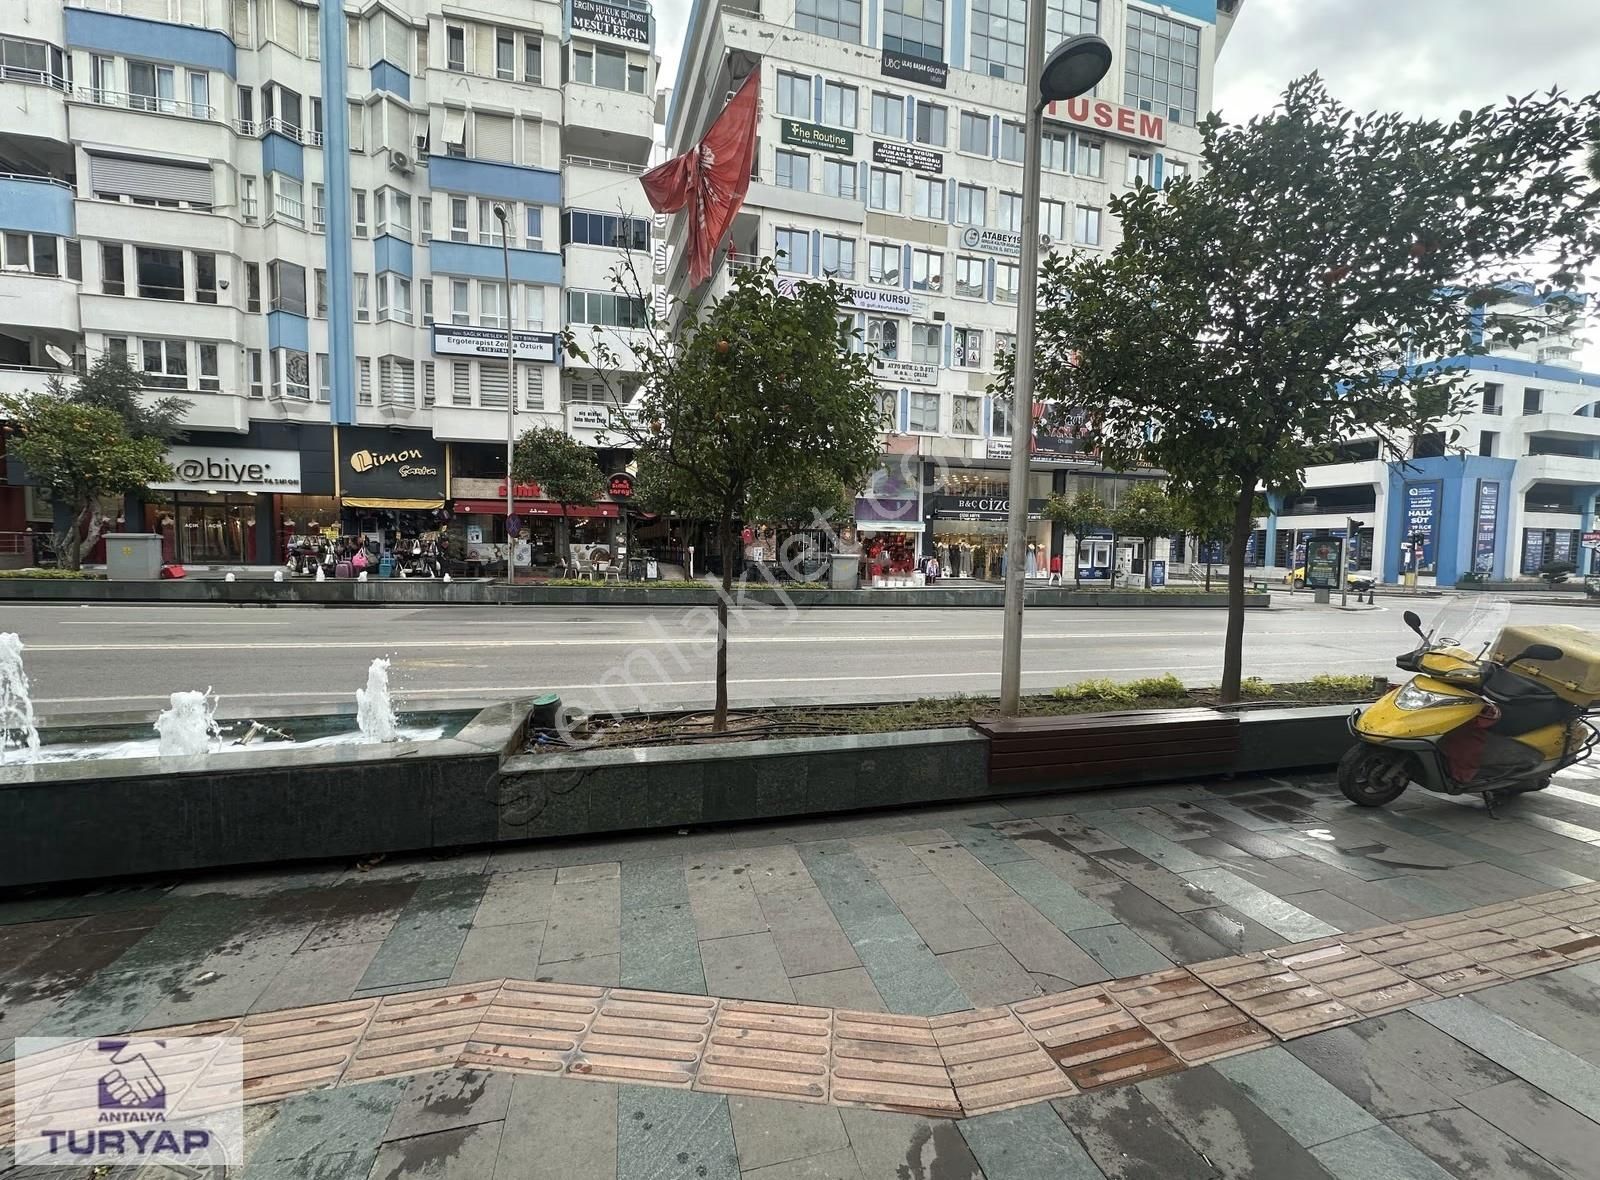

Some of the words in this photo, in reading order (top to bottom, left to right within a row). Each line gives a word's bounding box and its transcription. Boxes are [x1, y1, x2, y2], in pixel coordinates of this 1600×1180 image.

[594, 14, 627, 26] AVUKAT
[596, 4, 620, 18] HUKUK
[621, 10, 646, 23] BÜROSU
[574, 17, 610, 32] MESUT
[613, 25, 647, 40] ERGİN
[791, 122, 810, 138] The
[813, 130, 846, 145] Routine
[879, 293, 910, 305] KURSU
[448, 337, 493, 346] Ergoterapist
[352, 449, 422, 472] Limon
[176, 457, 263, 484] @biye
[399, 465, 437, 477] Çanta
[498, 482, 542, 497] smit
[979, 498, 1009, 510] CİZG
